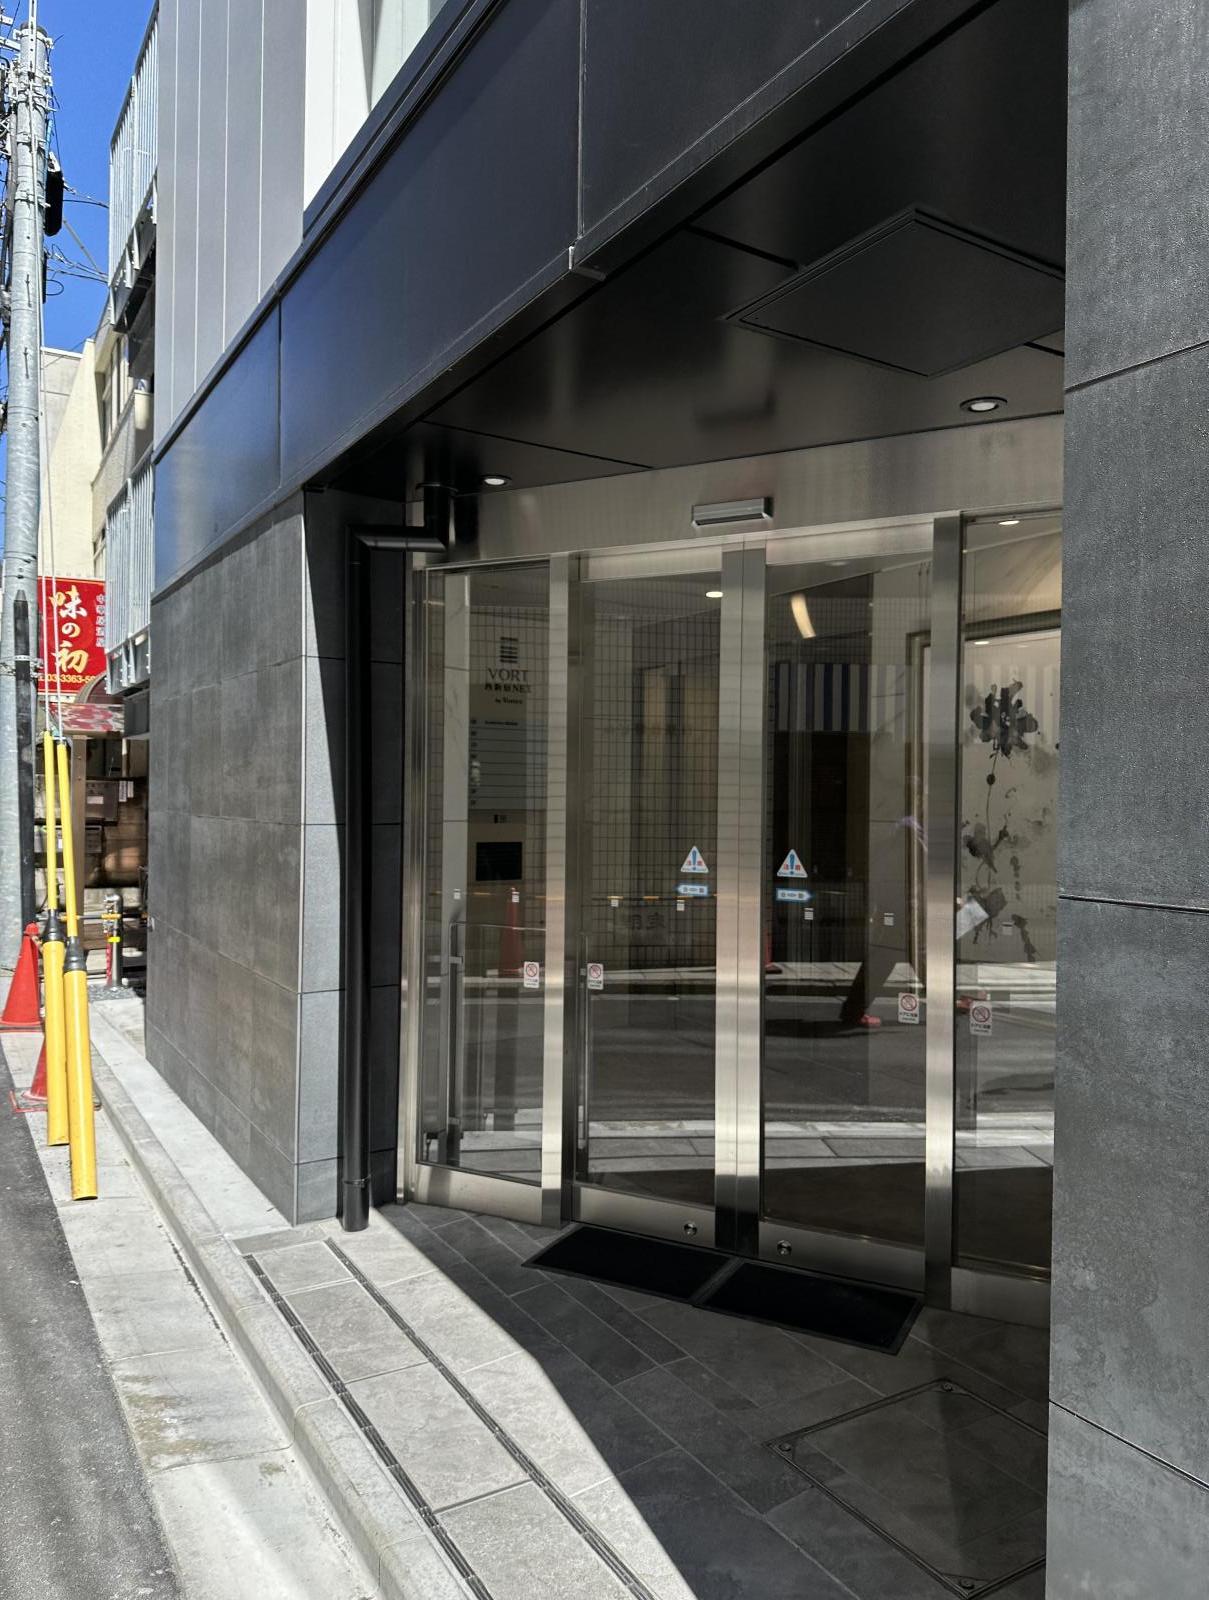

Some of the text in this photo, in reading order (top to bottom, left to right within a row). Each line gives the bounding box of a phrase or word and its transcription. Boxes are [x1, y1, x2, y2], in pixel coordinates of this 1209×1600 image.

[49, 585, 89, 674] 味の初
[487, 668, 528, 681] VORT
